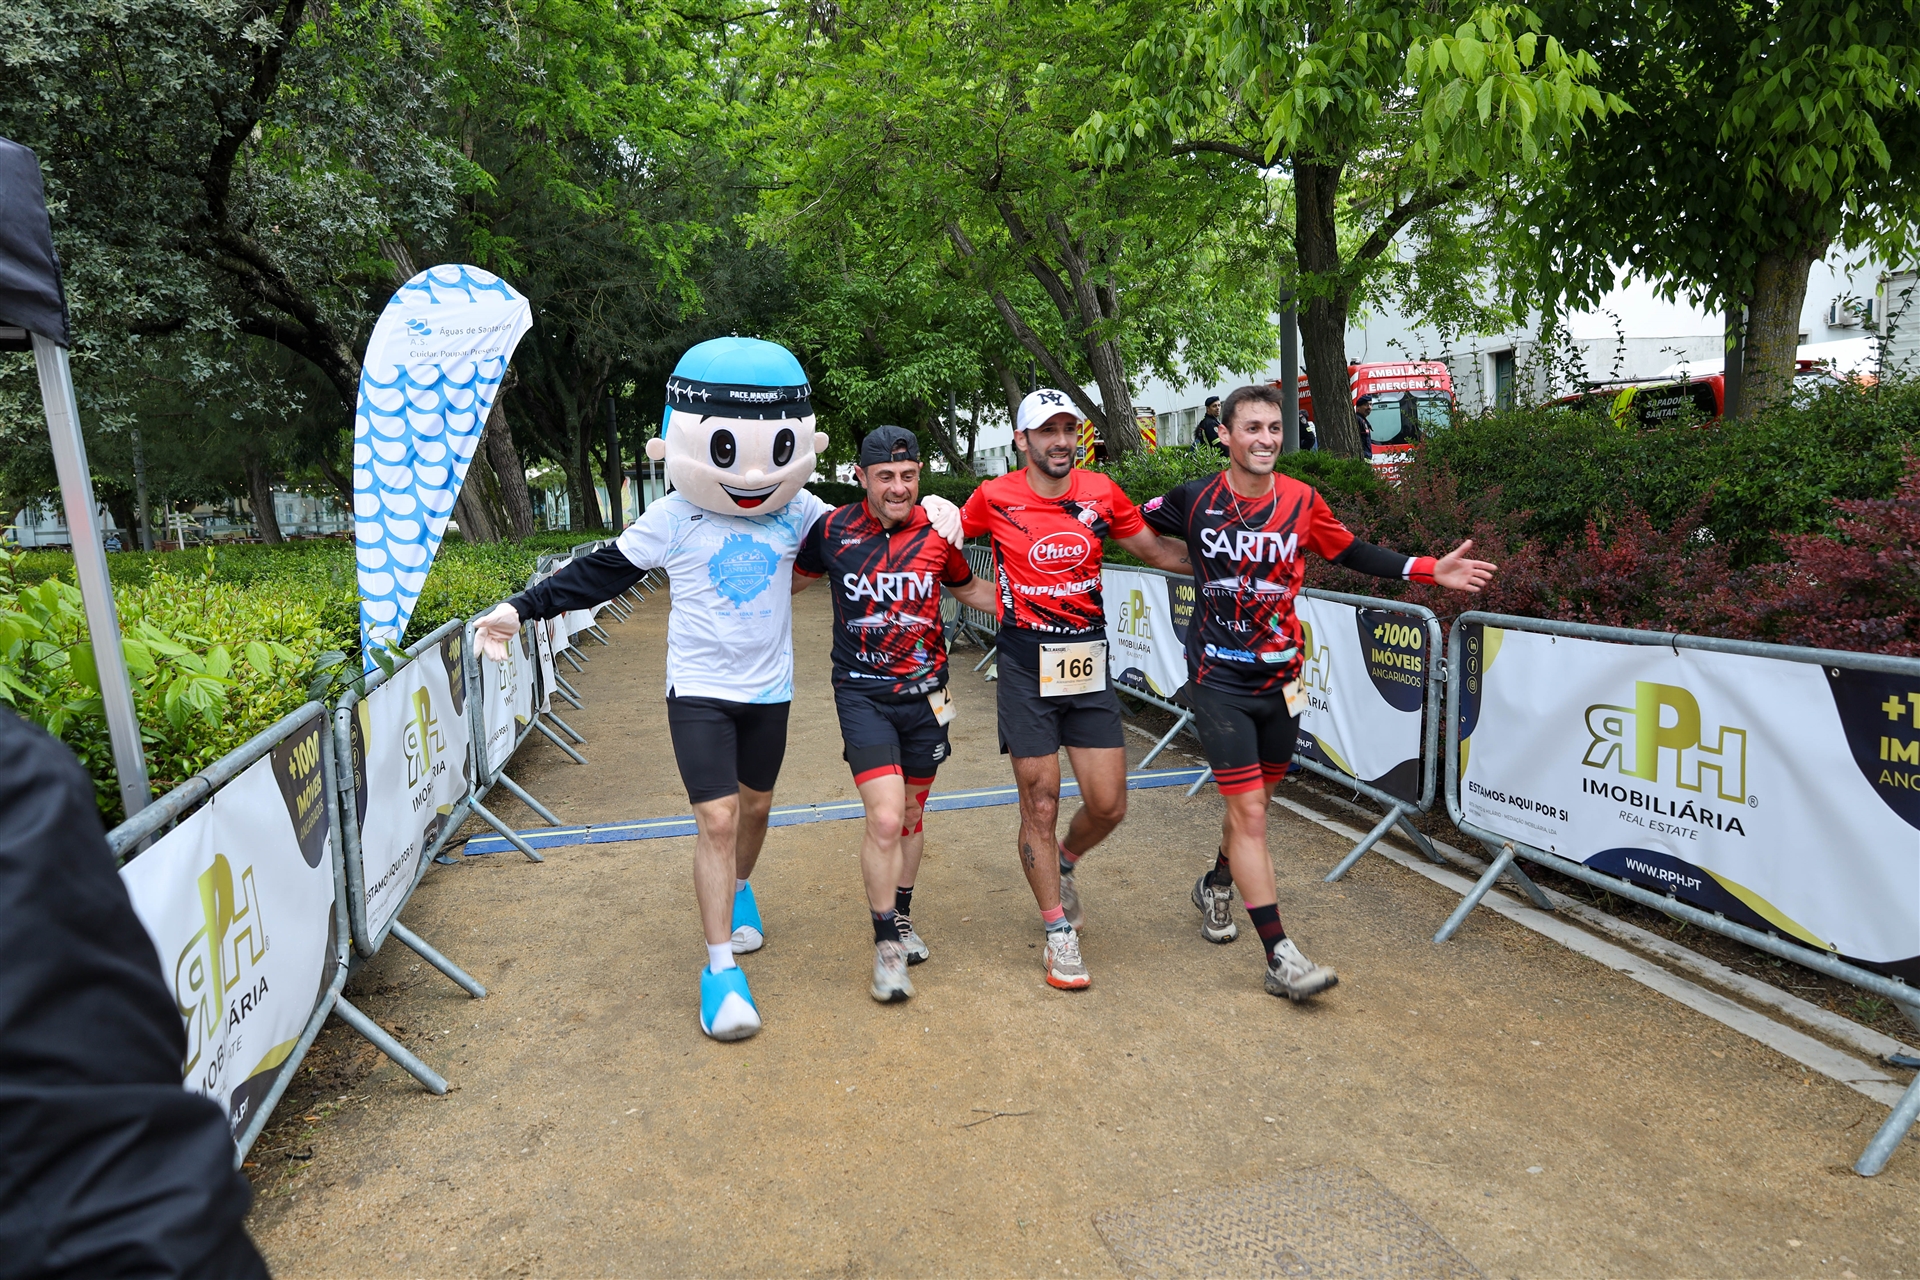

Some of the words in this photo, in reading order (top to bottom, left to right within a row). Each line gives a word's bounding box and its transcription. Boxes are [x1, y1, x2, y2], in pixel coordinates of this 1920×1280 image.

[440, 327, 464, 337] Águas
[466, 327, 476, 335] de
[1367, 367, 1440, 379] AMBULÂNCIA
[730, 390, 748, 399] PACE
[750, 391, 779, 400] MAKERS
[1032, 542, 1085, 562] Chico
[1373, 622, 1423, 651] +1000
[1056, 657, 1094, 679] 166
[1371, 647, 1422, 673] IMÓVEIS
[1371, 667, 1421, 688] ANGARIADOS
[288, 730, 320, 780] +1000
[295, 769, 322, 820] IMÓVEIS
[1468, 780, 1506, 803] ESTAMOS
[1508, 795, 1533, 811] AQUI
[1535, 802, 1557, 819] POR
[1559, 809, 1568, 822] SI
[1582, 777, 1746, 837] IMOBILIÁRIA
[299, 797, 324, 843] ANGARIADOS
[1618, 810, 1646, 827] REAL
[1648, 819, 1699, 841] ESTATE
[1625, 856, 1702, 891] WWW.RPH.PT
